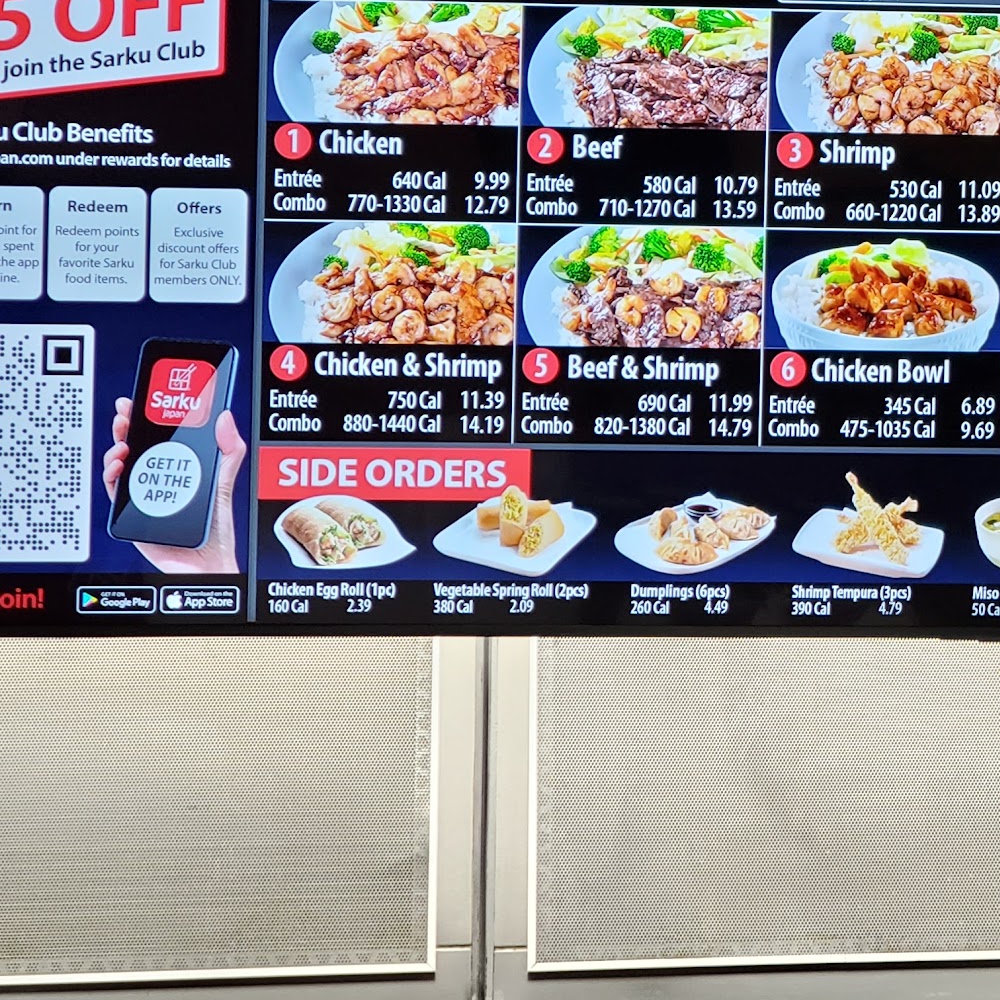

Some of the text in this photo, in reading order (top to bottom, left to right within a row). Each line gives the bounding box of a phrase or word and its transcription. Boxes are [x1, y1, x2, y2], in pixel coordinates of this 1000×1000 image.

[2, 41, 205, 83] join the Sarku Club
[12, 122, 153, 143] Club Benefits
[287, 129, 402, 155] 1 Chicken
[539, 134, 623, 158] 2 Beef
[56, 154, 231, 168] under rewards for details
[788, 139, 895, 170] 3 Shrimp
[274, 168, 509, 190] Entrée 640 Cal 9.99
[68, 200, 128, 213] Redeem
[177, 202, 221, 214] Offers
[273, 192, 509, 214] Combo 770-1330 Cal 12.79
[174, 228, 223, 238] Exclusive
[158, 242, 238, 254] discount offers
[160, 259, 236, 270] for Sarku Club
[155, 275, 241, 286] members ONLY.
[281, 351, 501, 383] 4 Chicken & Shrimp
[535, 353, 719, 386] 5 Beef & Shrimp
[781, 357, 949, 384] 6 Chicken Bowl
[151, 391, 201, 410] Sarku
[769, 395, 995, 415] Entrée 345 Cal 6.89
[768, 418, 994, 439] Combo 475-1035 Cal 9.69
[146, 457, 191, 471] GET IT
[138, 473, 191, 488] ON THE
[278, 458, 506, 488] SIDE ORDERS
[144, 490, 176, 503] APP!
[268, 582, 313, 597] Chicken
[316, 583, 338, 600] Egg
[341, 583, 364, 597] Roll
[972, 587, 998, 600] Miso
[101, 597, 150, 609] Google Play
[184, 596, 232, 608] App Store
[268, 599, 371, 613] 160 Cal 2.39
[971, 603, 986, 617] 50
